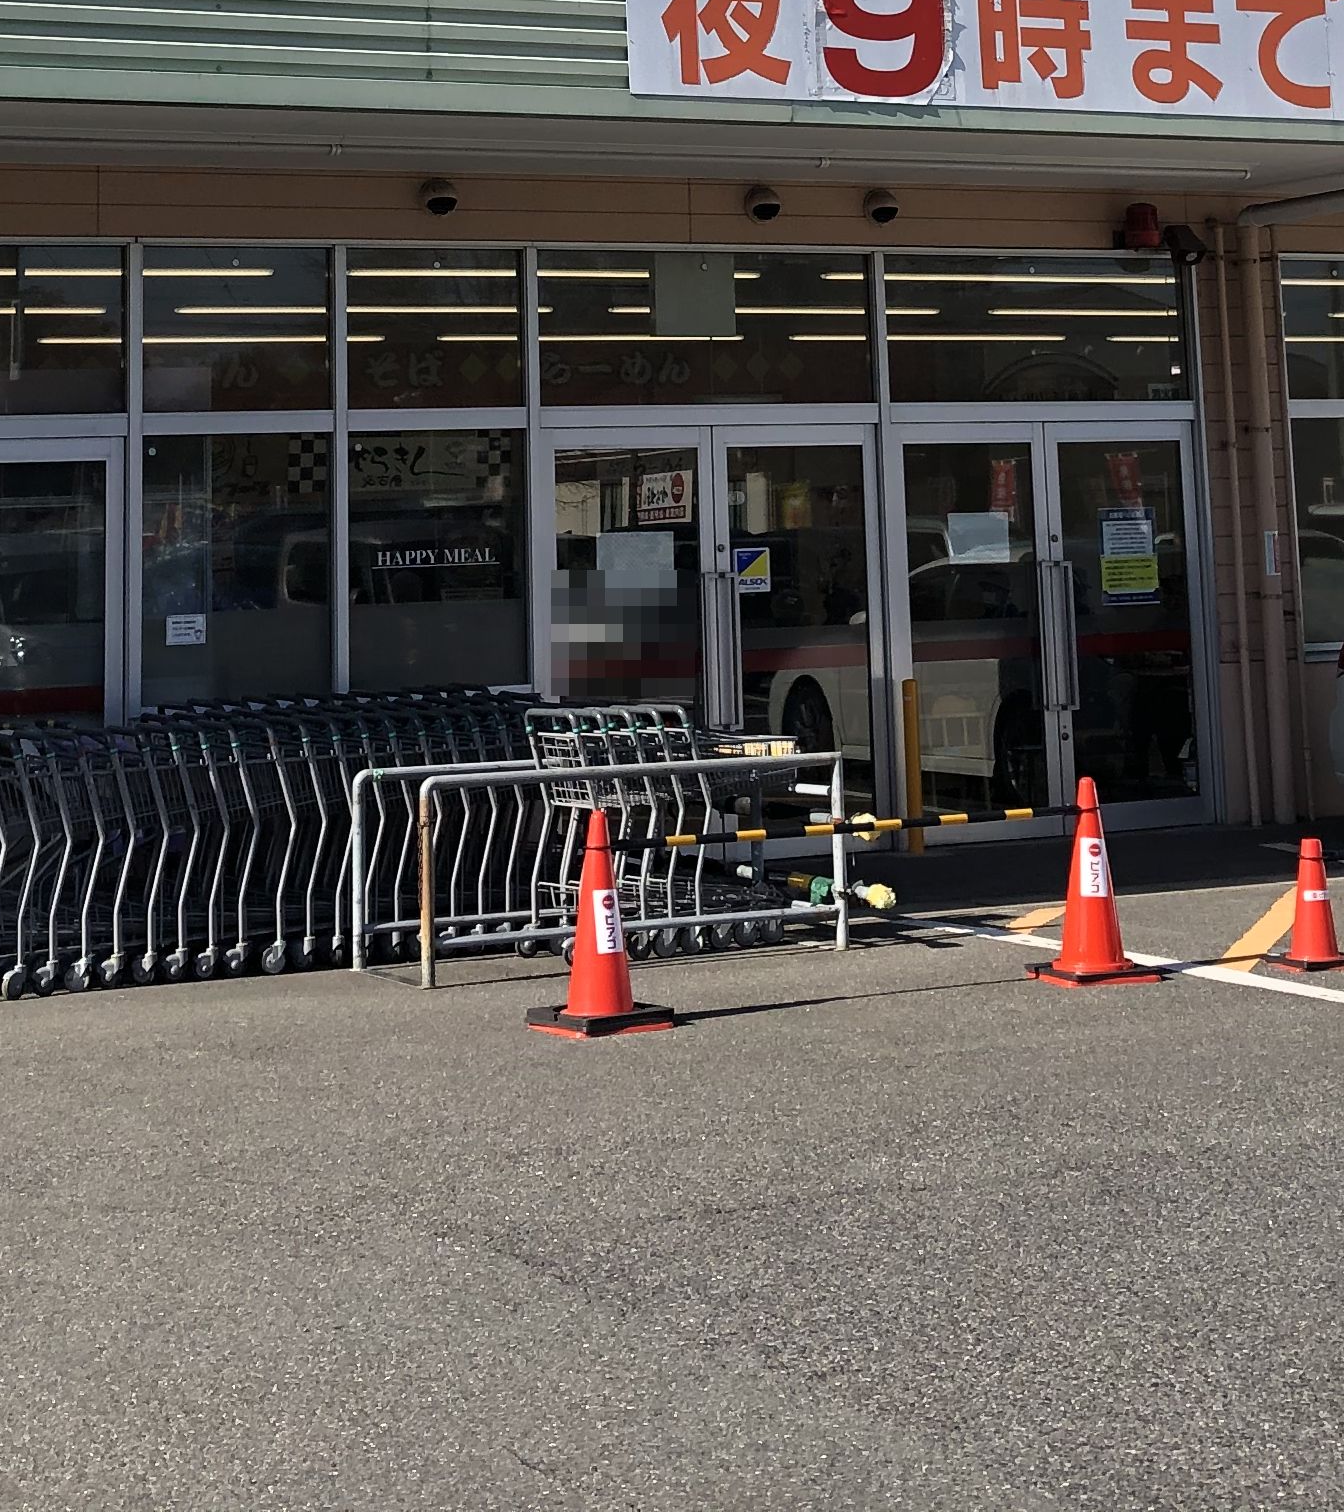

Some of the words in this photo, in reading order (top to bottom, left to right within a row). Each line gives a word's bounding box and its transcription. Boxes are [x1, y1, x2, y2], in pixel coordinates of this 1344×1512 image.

[541, 351, 692, 386] らーめん
[376, 549, 439, 566] HAPPY
[444, 547, 496, 564] MEAL
[739, 577, 768, 586] ALSOK
